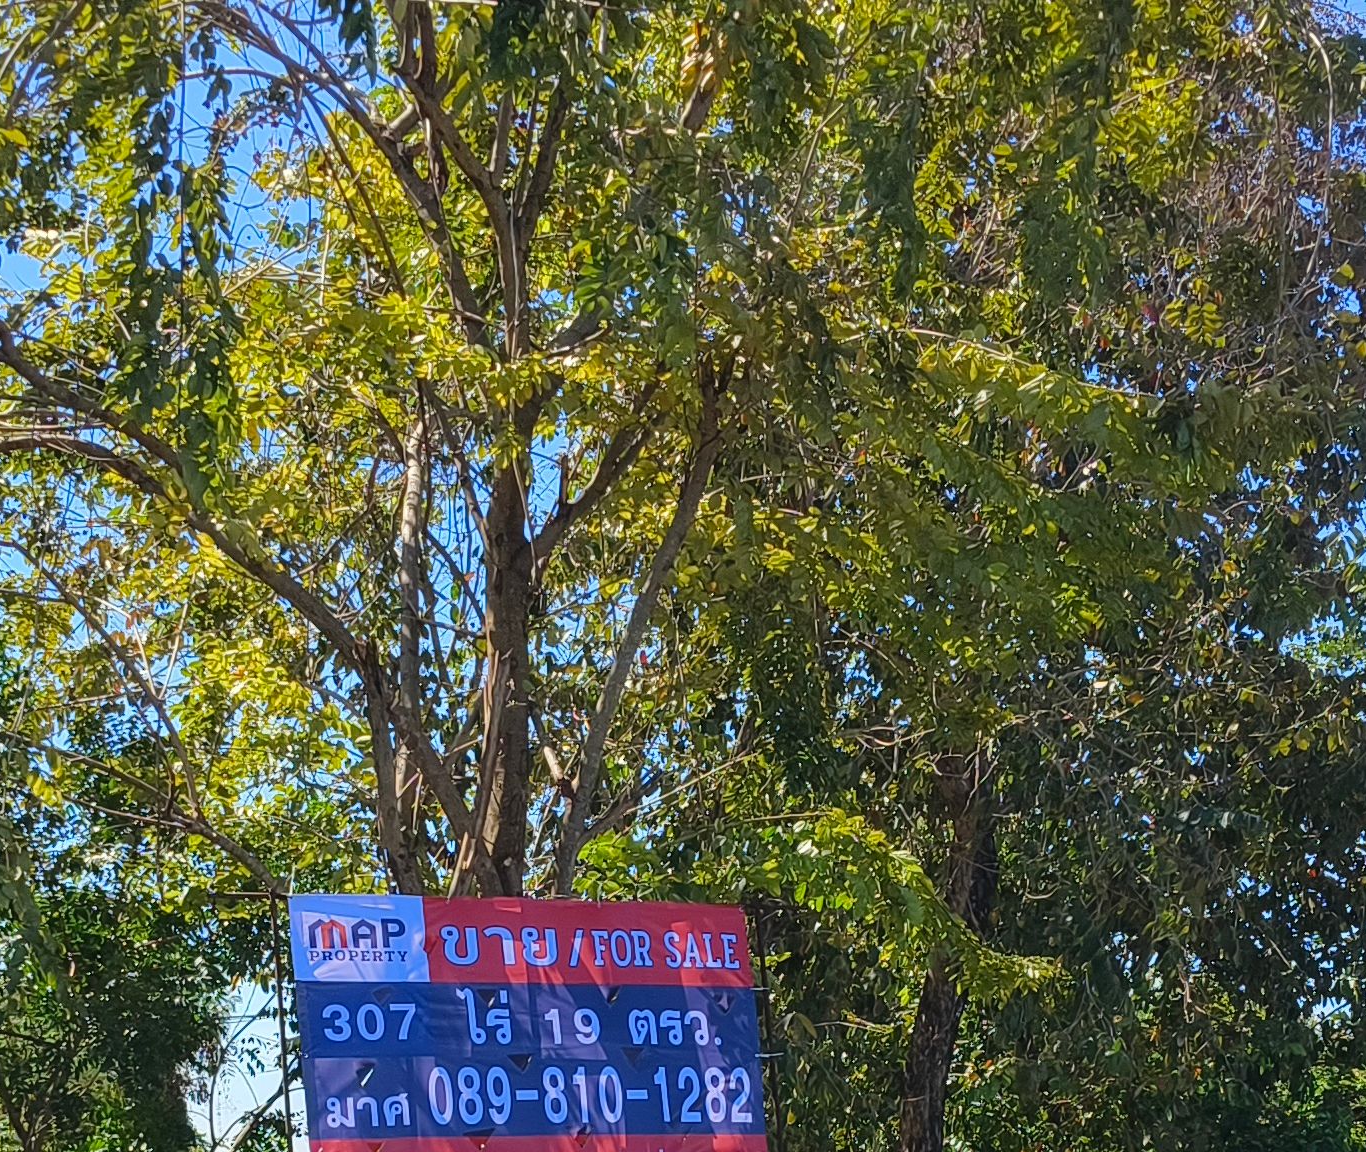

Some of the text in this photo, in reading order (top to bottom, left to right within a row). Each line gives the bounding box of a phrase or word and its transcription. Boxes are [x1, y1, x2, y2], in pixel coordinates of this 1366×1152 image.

[309, 919, 406, 949] MAP
[309, 951, 408, 962] PROPERTY
[440, 925, 559, 966] ขาย
[590, 928, 654, 968] FOR
[663, 930, 741, 970] SALE
[322, 987, 722, 1046] 307 ไร่ 19 ตรว.
[326, 1066, 753, 1128] มาศ 089-810-1282
